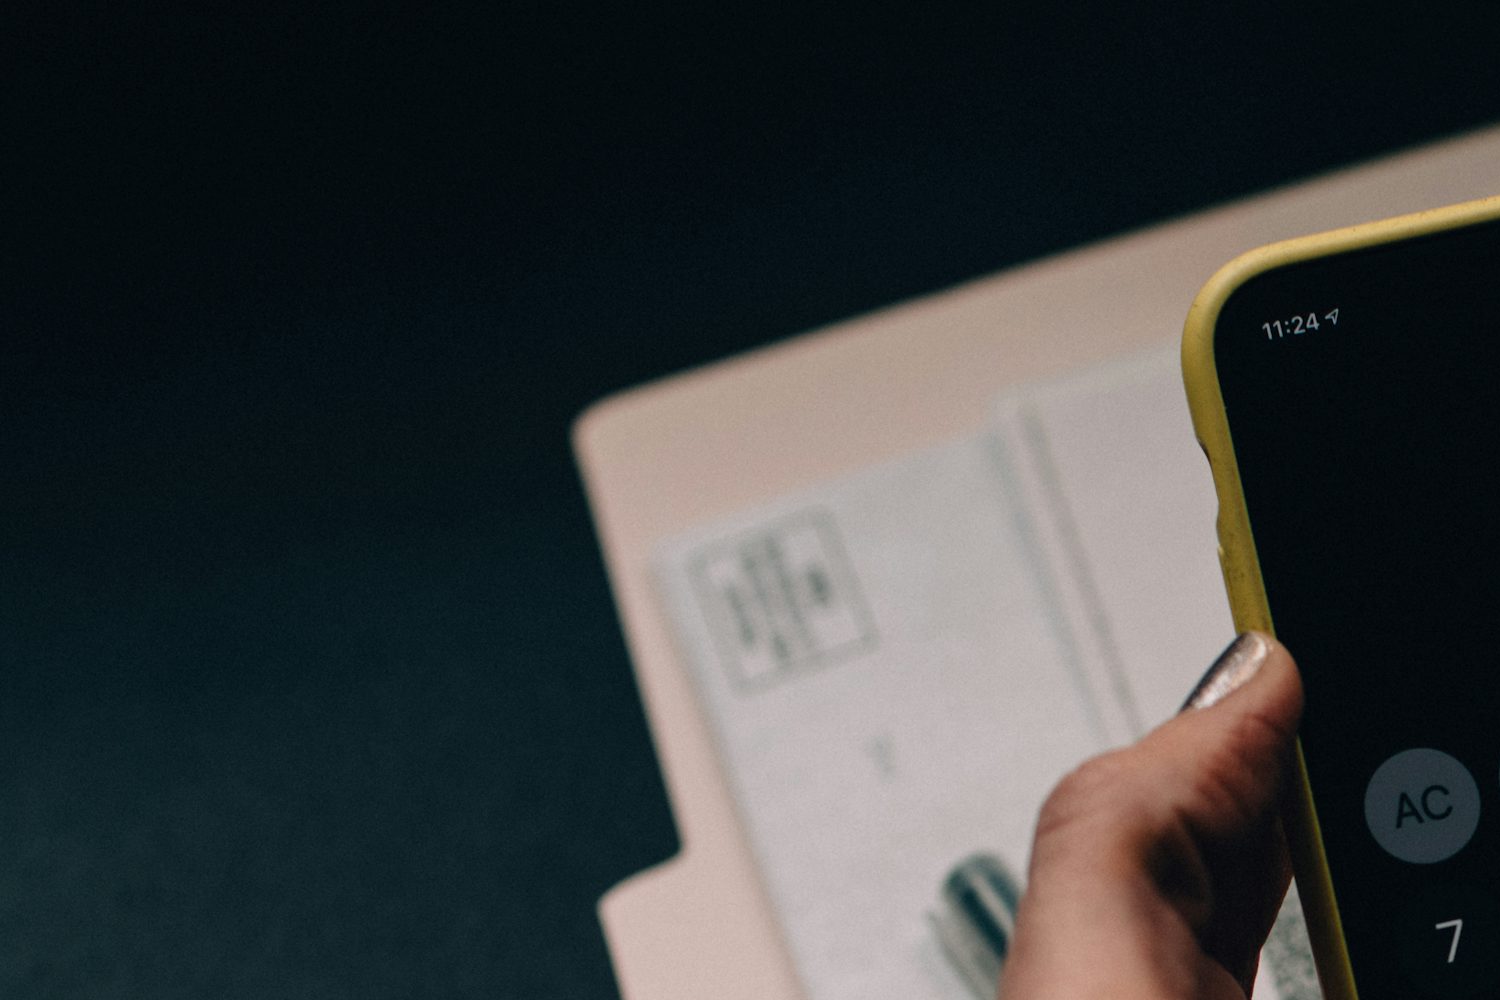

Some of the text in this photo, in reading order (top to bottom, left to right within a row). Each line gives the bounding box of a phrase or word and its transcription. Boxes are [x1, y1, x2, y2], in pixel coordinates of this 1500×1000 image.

[1261, 311, 1321, 341] 11:24
[1395, 784, 1454, 830] AC
[1434, 917, 1464, 964] 7
